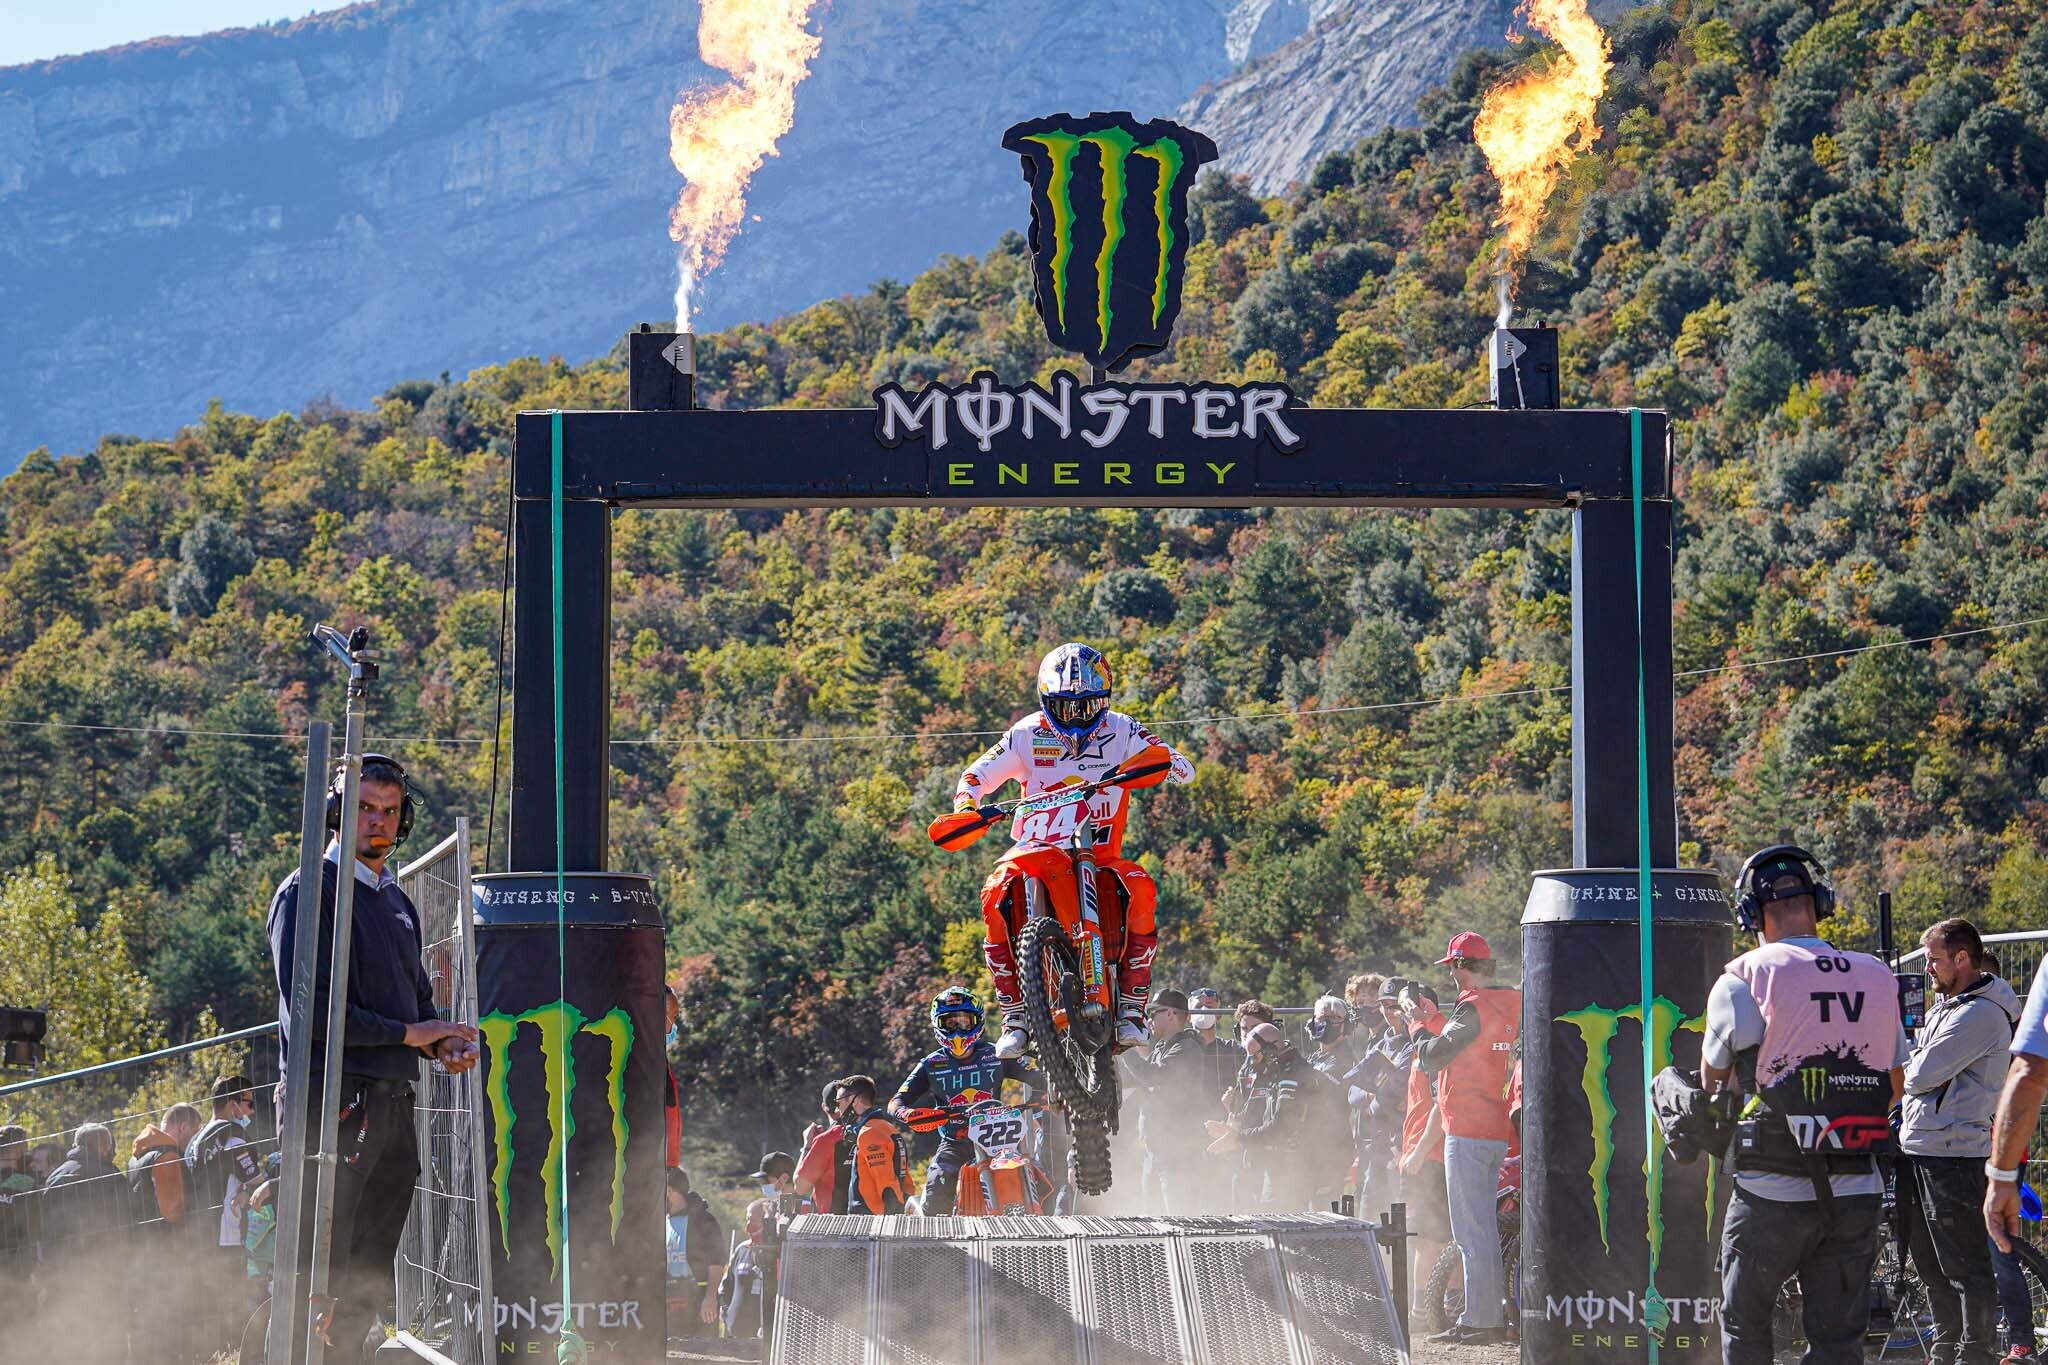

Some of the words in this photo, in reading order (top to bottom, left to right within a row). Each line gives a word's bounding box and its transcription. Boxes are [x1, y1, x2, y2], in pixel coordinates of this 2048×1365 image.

[877, 376, 1301, 452] MONSTER
[948, 462, 1236, 485] ENERGY
[1090, 801, 1111, 819] ull
[1020, 803, 1078, 842] 84
[1815, 955, 1851, 973] 60
[1810, 991, 1865, 1023] TV
[1828, 1073, 1880, 1087] MONSTER
[978, 1120, 1022, 1147] 222
[1571, 1334, 1710, 1349] ENEGY
